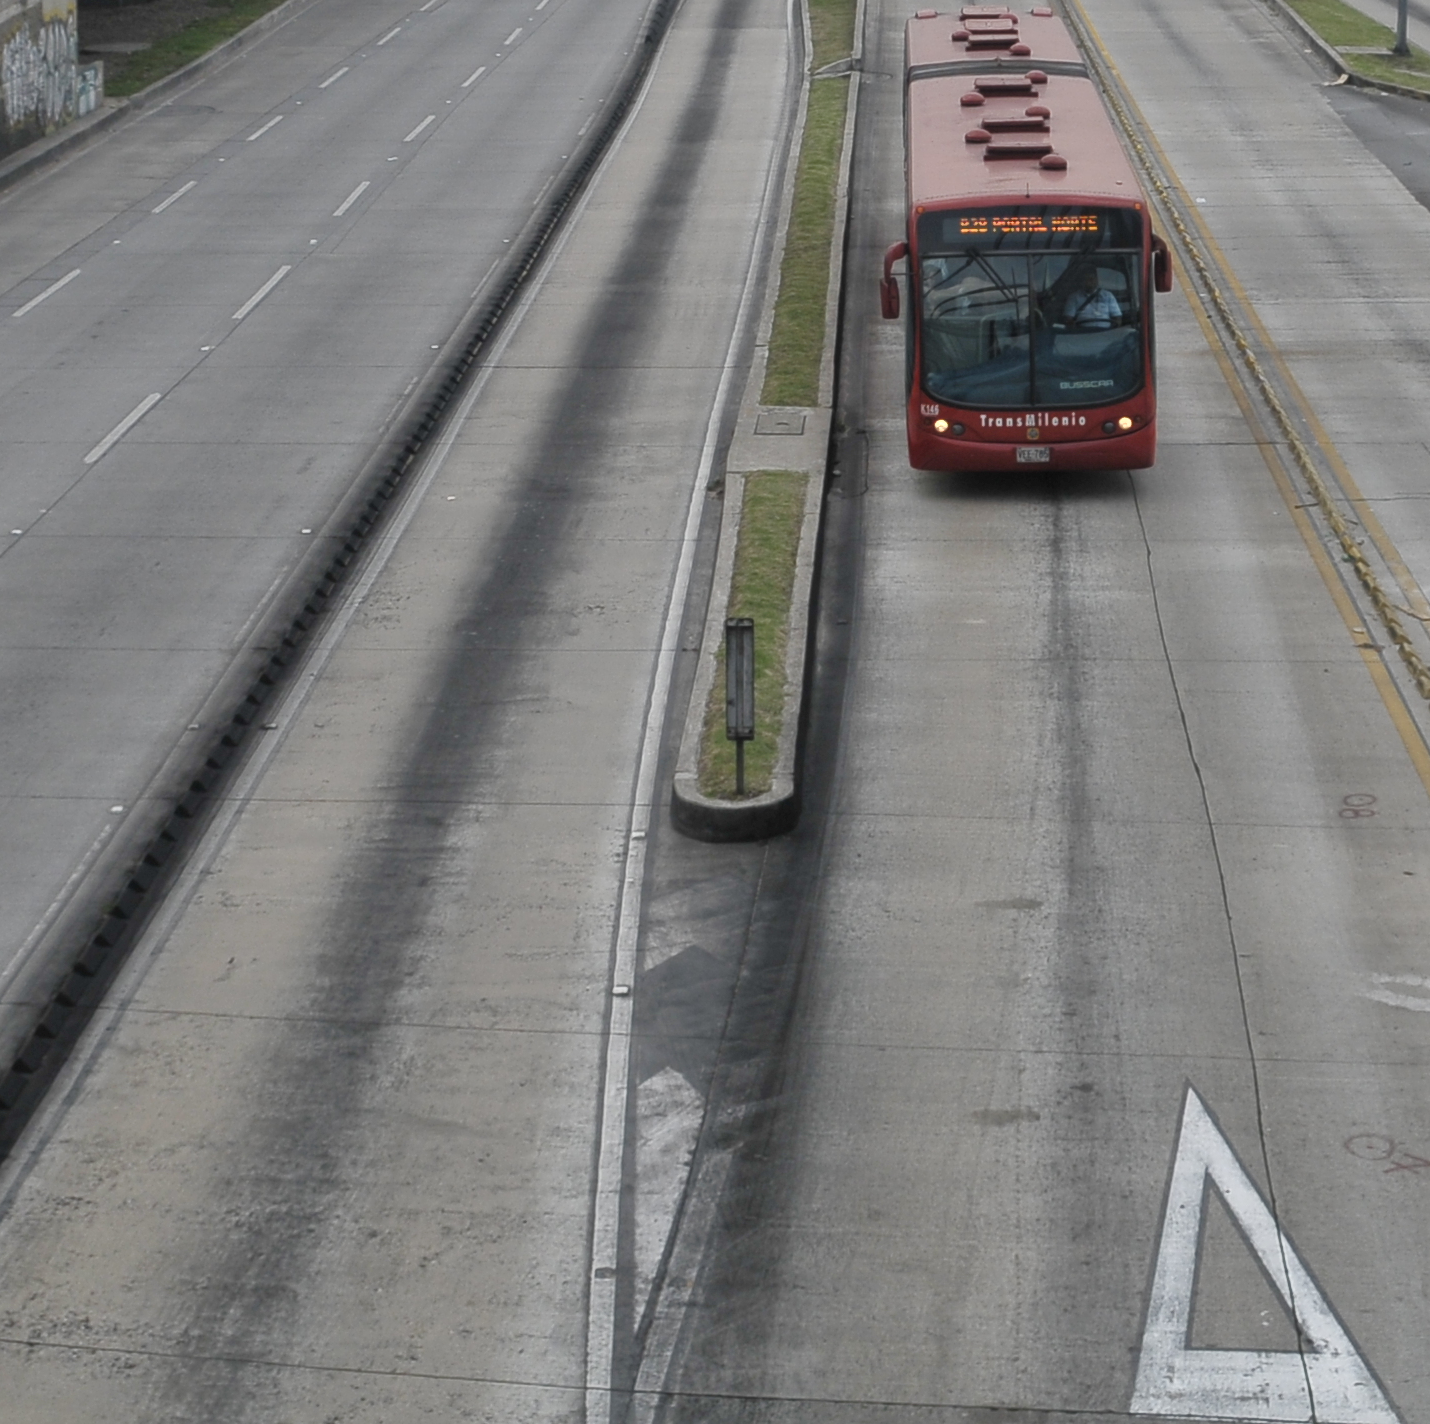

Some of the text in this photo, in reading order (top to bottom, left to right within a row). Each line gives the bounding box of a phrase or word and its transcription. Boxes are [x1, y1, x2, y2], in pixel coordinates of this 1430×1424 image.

[992, 216, 1048, 233] PORTAL
[1051, 215, 1098, 231] NORTE
[1059, 379, 1114, 390] BUSSCAR
[979, 412, 1086, 427] TransMilenio
